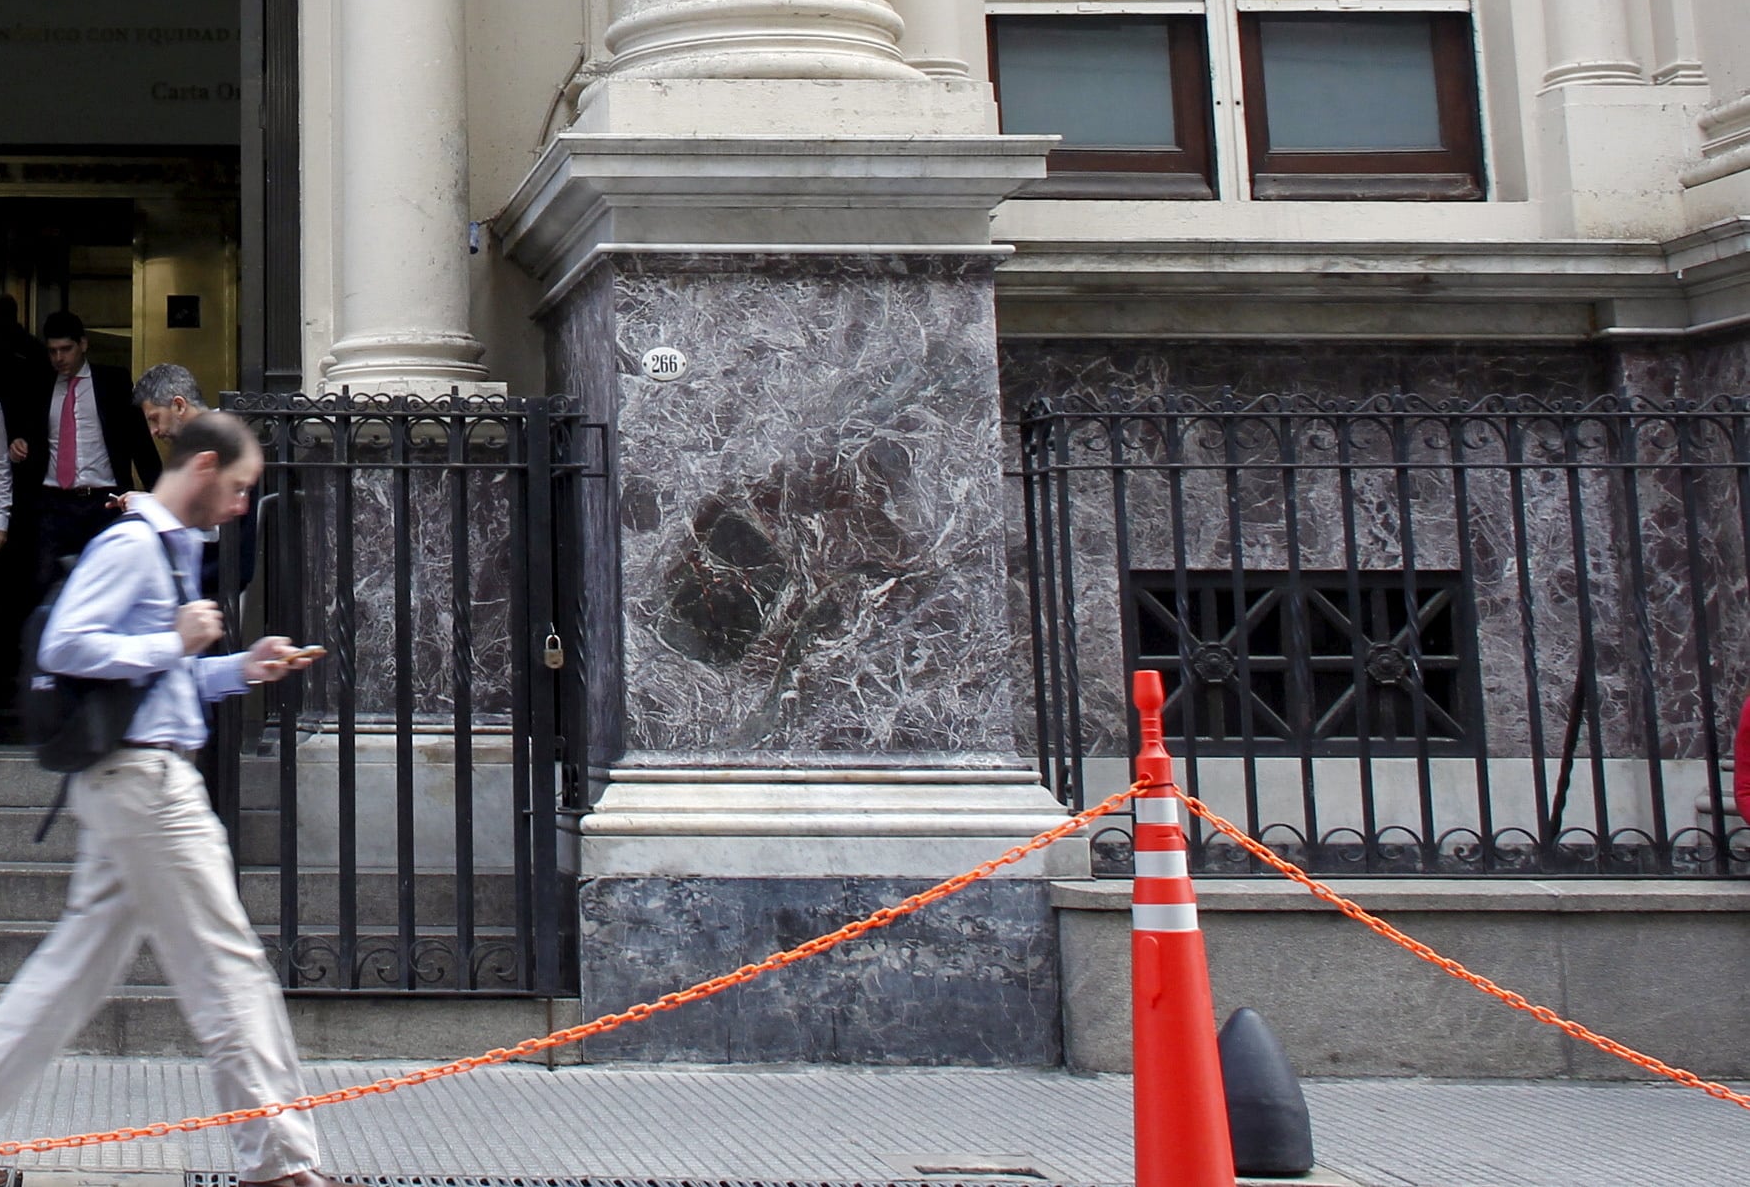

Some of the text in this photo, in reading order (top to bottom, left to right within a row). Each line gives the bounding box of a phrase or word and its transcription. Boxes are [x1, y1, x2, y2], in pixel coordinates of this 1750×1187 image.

[86, 27, 129, 41] CON
[135, 26, 231, 44] EQUIDAD
[150, 81, 210, 101] Carta
[651, 354, 678, 373] 266
